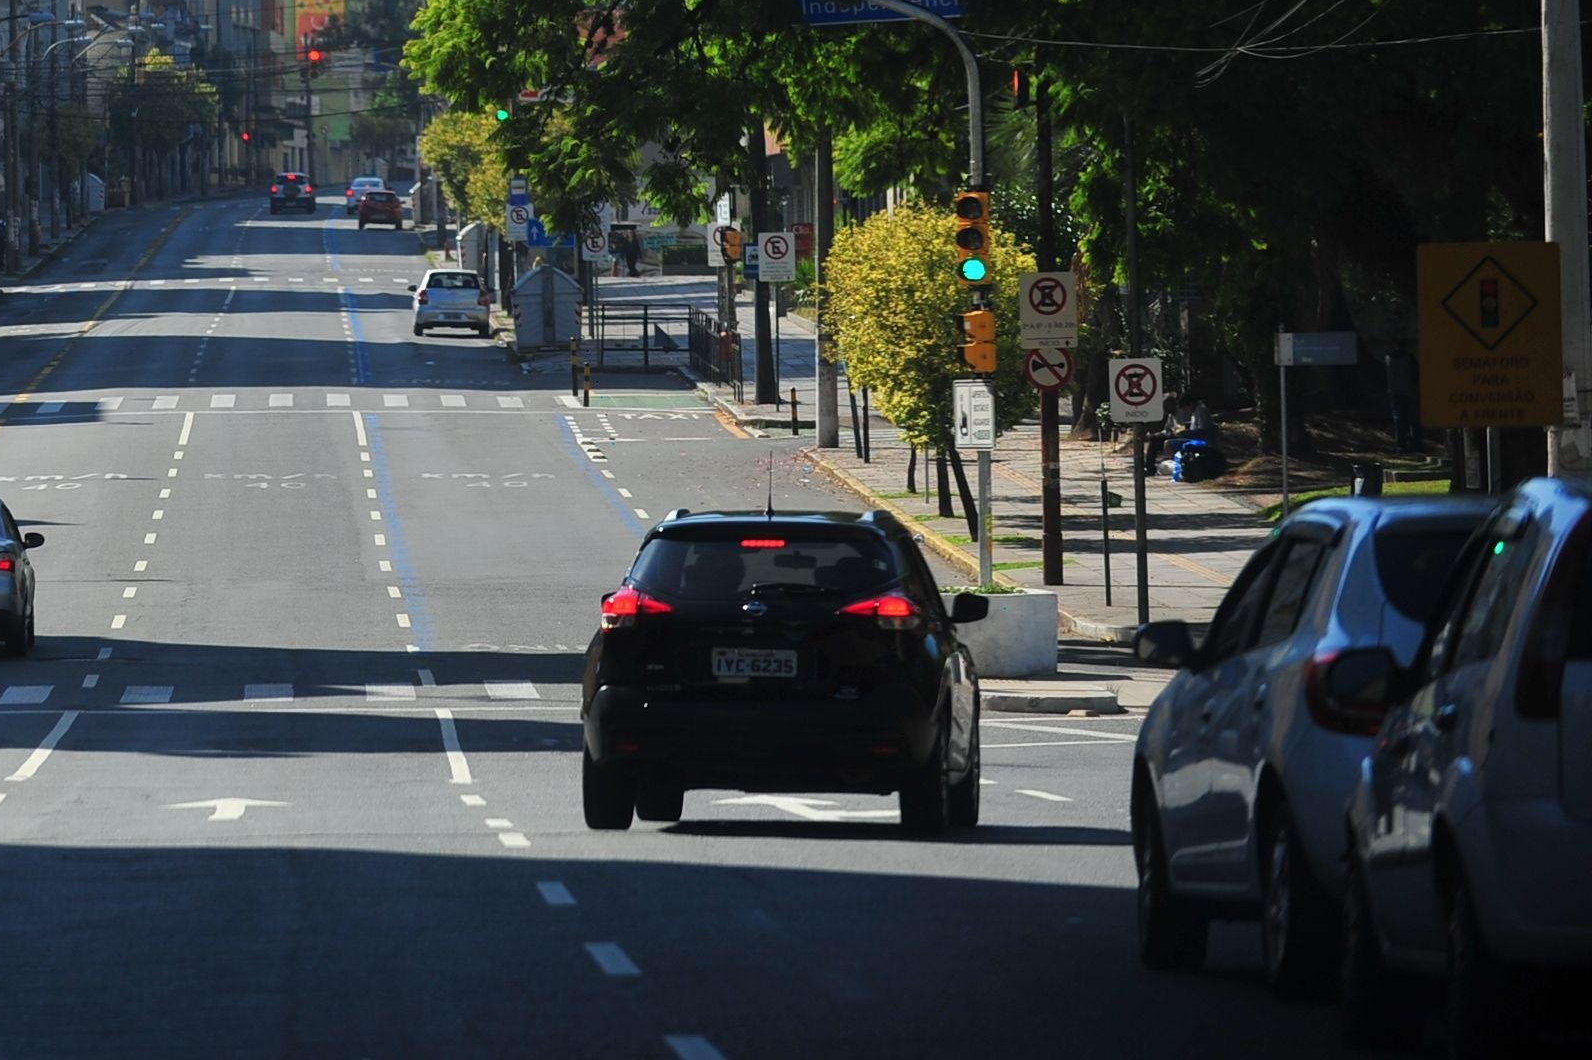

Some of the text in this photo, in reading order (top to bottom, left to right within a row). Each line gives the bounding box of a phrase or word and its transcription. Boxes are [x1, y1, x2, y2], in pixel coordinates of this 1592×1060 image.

[616, 412, 700, 421] TAXI
[20, 482, 83, 491] 40
[242, 481, 307, 490] 40
[464, 480, 529, 489] 40
